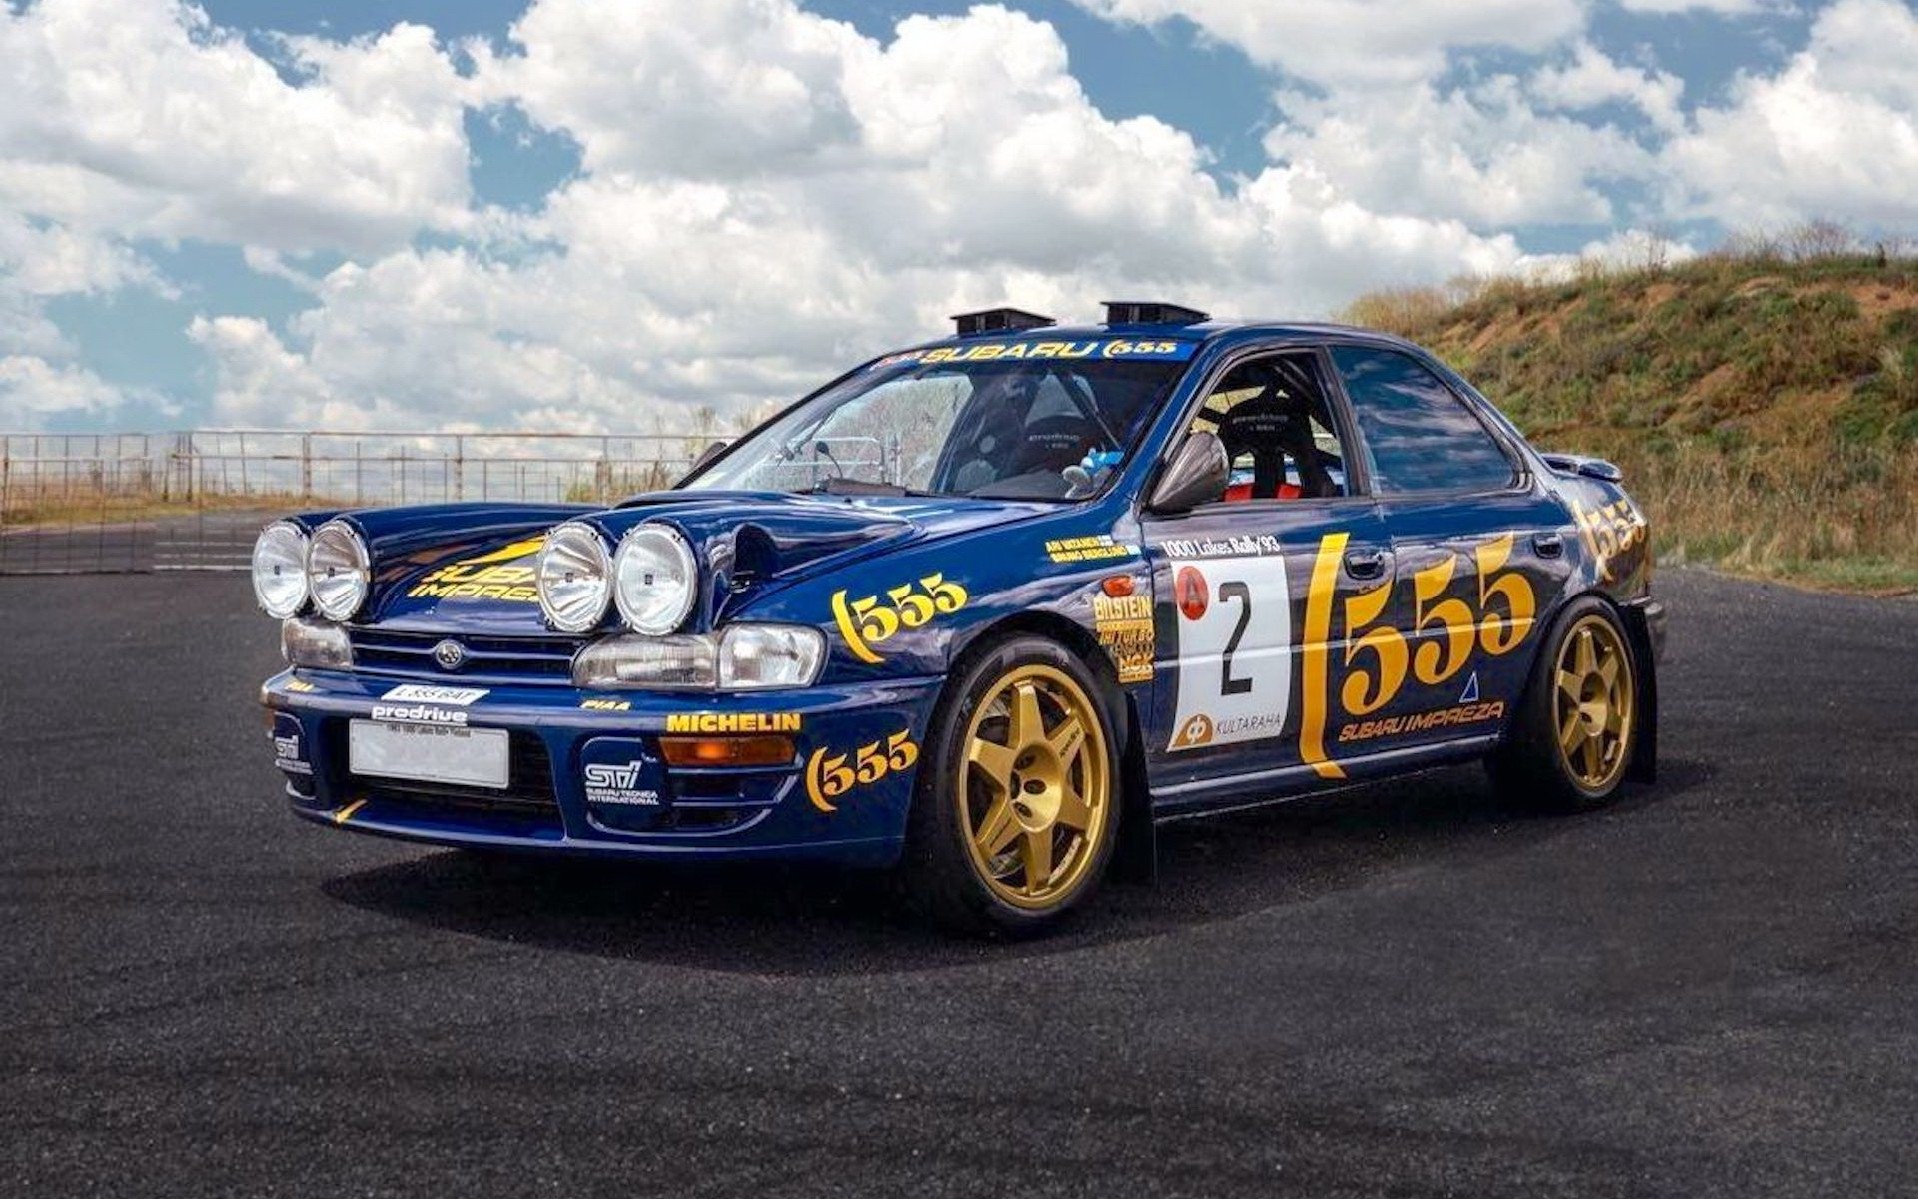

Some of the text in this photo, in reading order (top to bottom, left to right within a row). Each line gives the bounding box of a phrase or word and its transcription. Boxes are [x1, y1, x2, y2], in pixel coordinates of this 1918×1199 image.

[919, 343, 1100, 364] SUBARU
[1160, 540, 1197, 557] 1000
[1194, 537, 1233, 555] Lakes
[1094, 596, 1153, 620] BILSTEIN
[1218, 581, 1254, 696] 2
[372, 705, 468, 722] prodrive
[666, 713, 801, 732] MICHELIN
[1339, 701, 1505, 742] SUBARU IMPREZA
[1216, 713, 1281, 735] KULTARAHA
[585, 788, 620, 797] SUBARU
[587, 795, 659, 805] INTERNATIONAL
